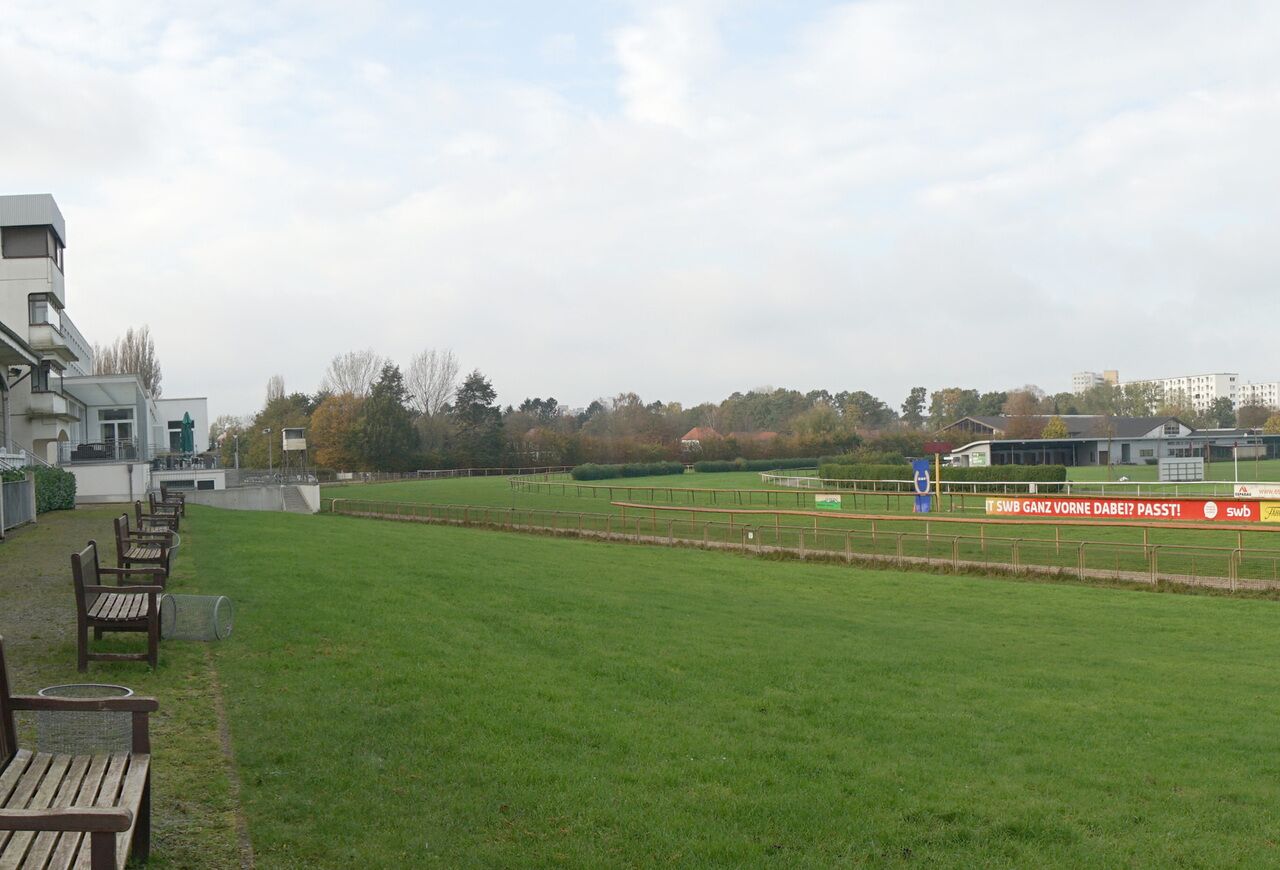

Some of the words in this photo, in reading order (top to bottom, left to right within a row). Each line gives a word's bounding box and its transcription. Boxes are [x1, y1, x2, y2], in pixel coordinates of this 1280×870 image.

[997, 500, 1020, 512] SWB
[1023, 501, 1052, 513] GANZ
[1054, 501, 1091, 514] VORNE
[1094, 502, 1134, 515] DABEI?
[1137, 502, 1181, 516] PASST!
[1226, 505, 1251, 517] swb
